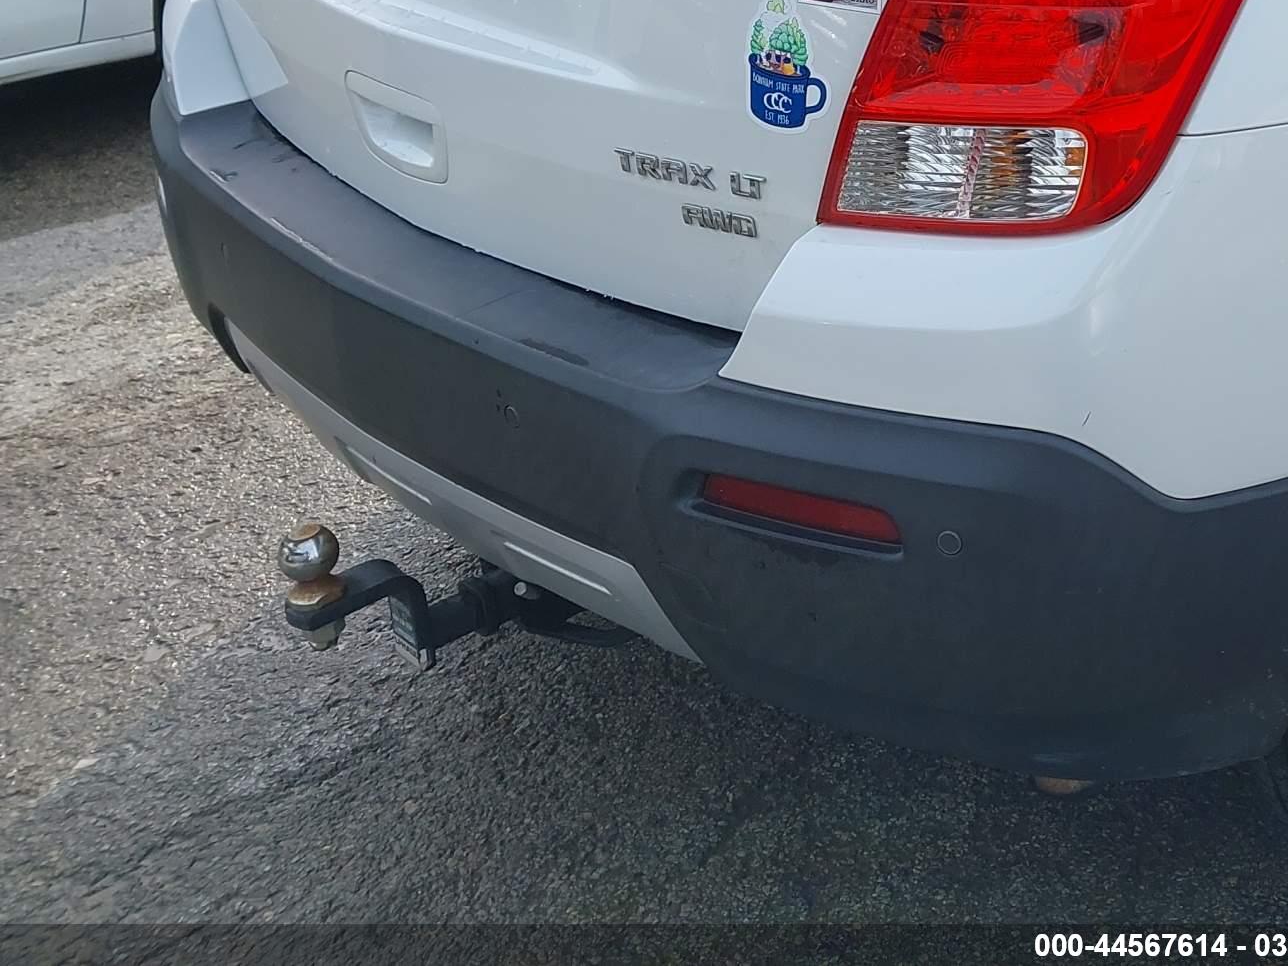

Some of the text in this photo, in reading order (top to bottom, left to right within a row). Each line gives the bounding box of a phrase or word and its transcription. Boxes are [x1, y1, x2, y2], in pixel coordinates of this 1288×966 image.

[763, 92, 793, 114] CCC
[613, 146, 767, 200] TRAX LT
[681, 202, 759, 239] AWD
